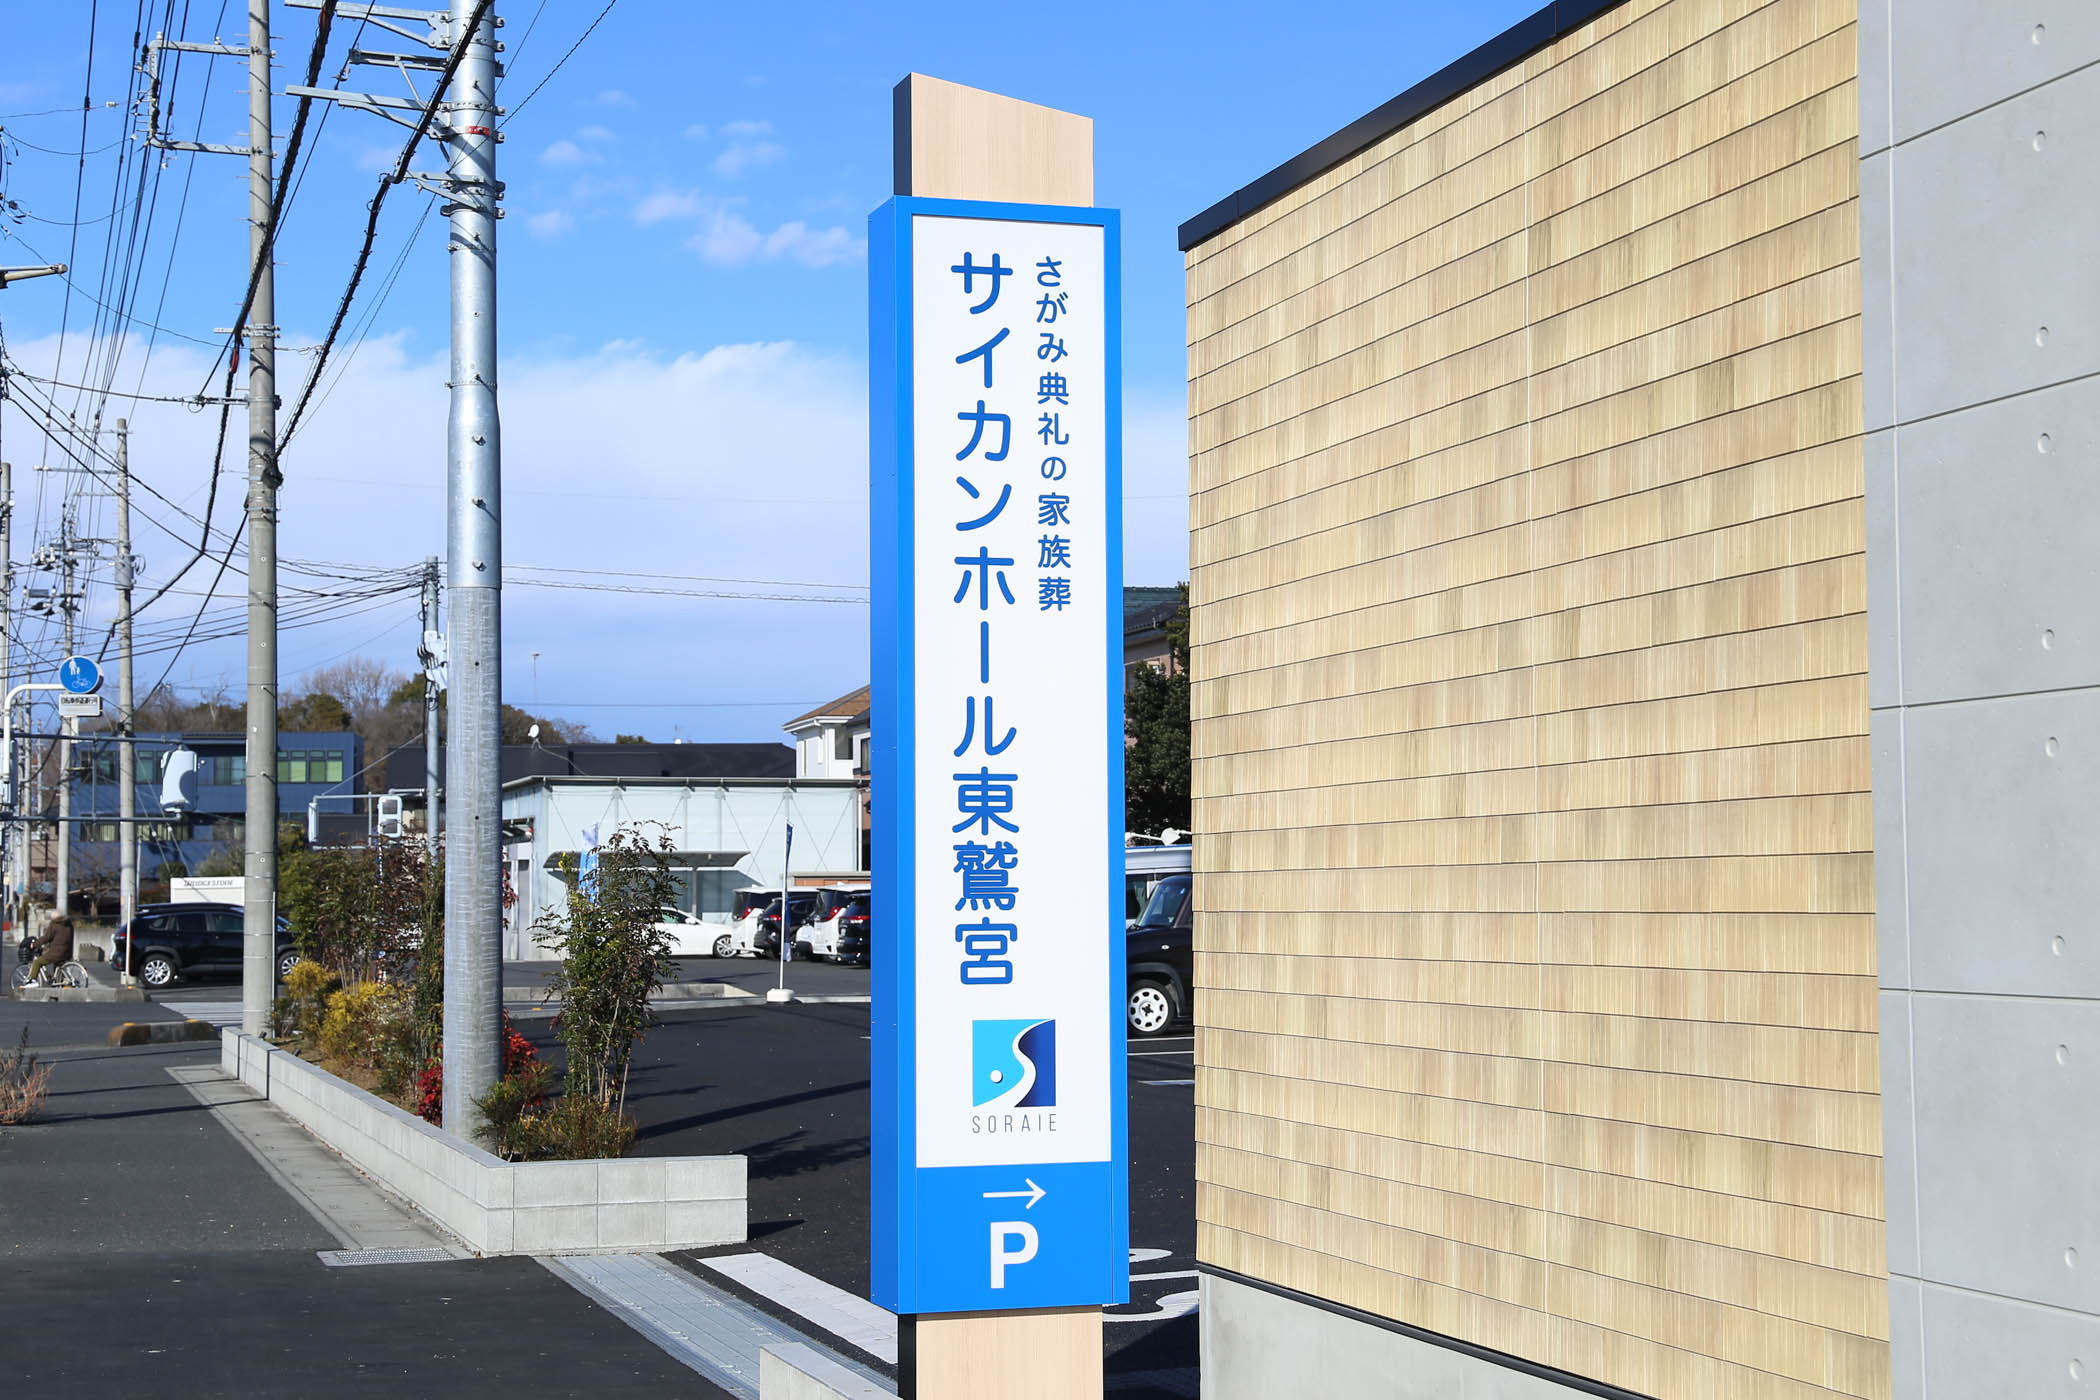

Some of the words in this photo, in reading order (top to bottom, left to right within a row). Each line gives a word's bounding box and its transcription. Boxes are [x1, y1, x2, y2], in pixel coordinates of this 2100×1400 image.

[1036, 256, 1071, 612] さがみ典礼の家族葬
[951, 252, 1019, 985] サイカンホール東鷲宮
[972, 1113, 1057, 1134] SORAIE
[990, 1221, 1039, 1289] P
